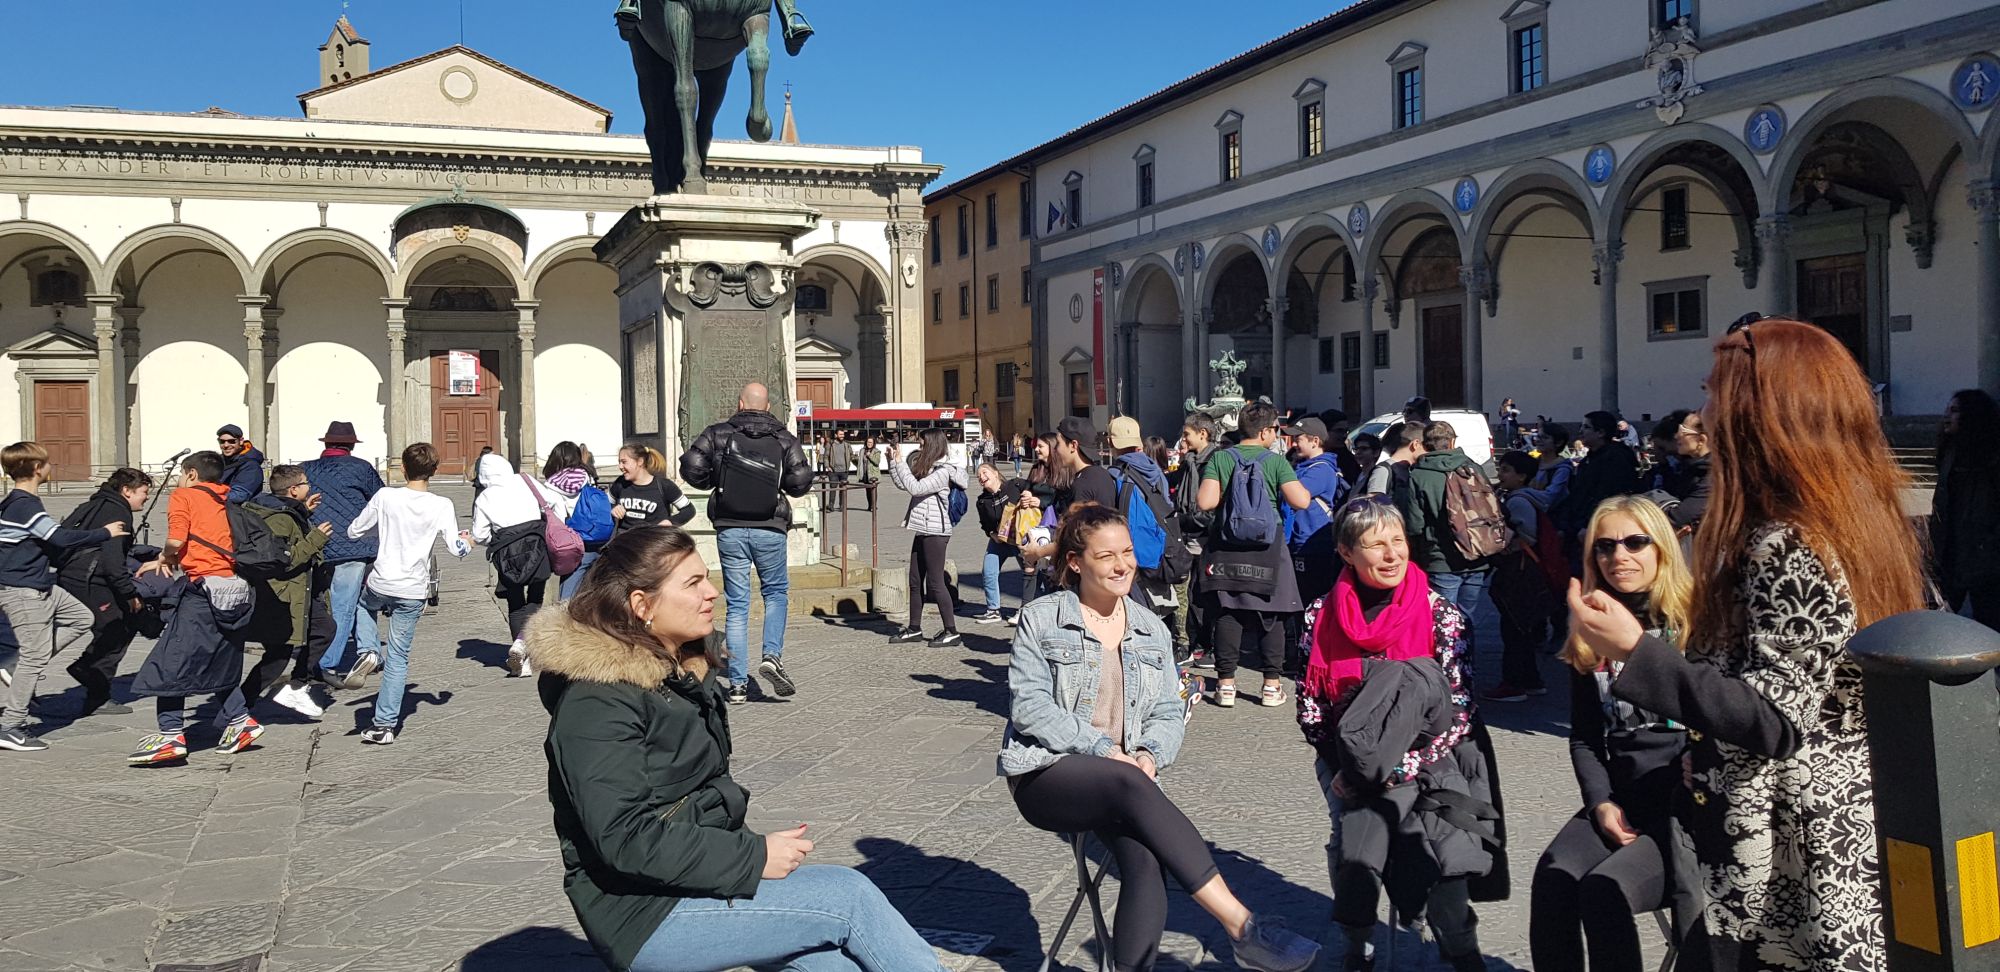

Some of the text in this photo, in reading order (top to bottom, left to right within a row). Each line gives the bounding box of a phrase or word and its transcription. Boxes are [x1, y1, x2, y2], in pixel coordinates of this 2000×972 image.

[0, 158, 170, 174] ALEXANDER
[204, 164, 231, 177] ET
[260, 165, 389, 182] ROBERTVS
[525, 177, 630, 192] FRATRES
[729, 185, 853, 201] GENITRICI
[619, 497, 658, 513] TOKYO
